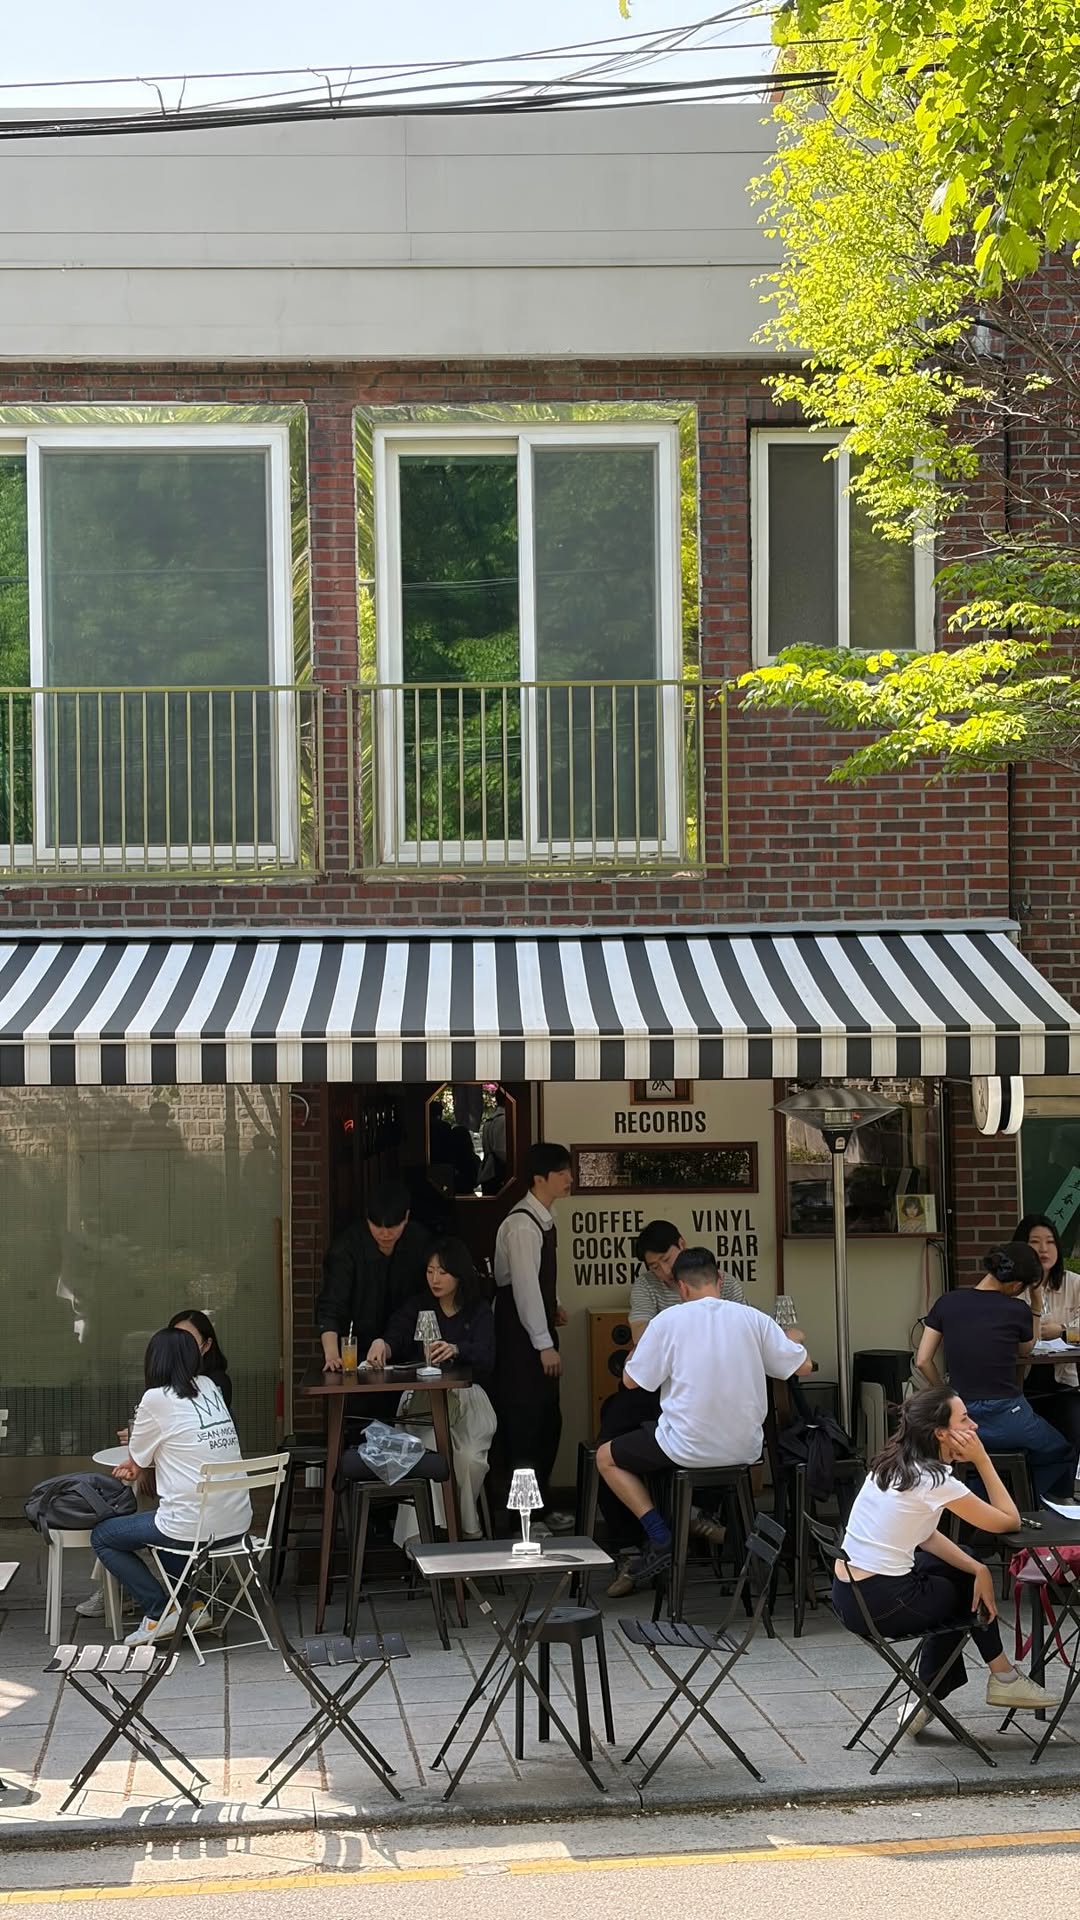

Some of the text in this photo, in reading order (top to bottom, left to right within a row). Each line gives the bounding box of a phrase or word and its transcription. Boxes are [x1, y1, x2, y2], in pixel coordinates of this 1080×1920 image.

[614, 1111, 707, 1133] RECORDS
[572, 1210, 644, 1234] COFFEE
[692, 1209, 756, 1232] VINYL
[572, 1236, 640, 1260] COCKT
[717, 1235, 759, 1257] BAR
[574, 1262, 643, 1286] WHISK
[717, 1260, 757, 1282] INE
